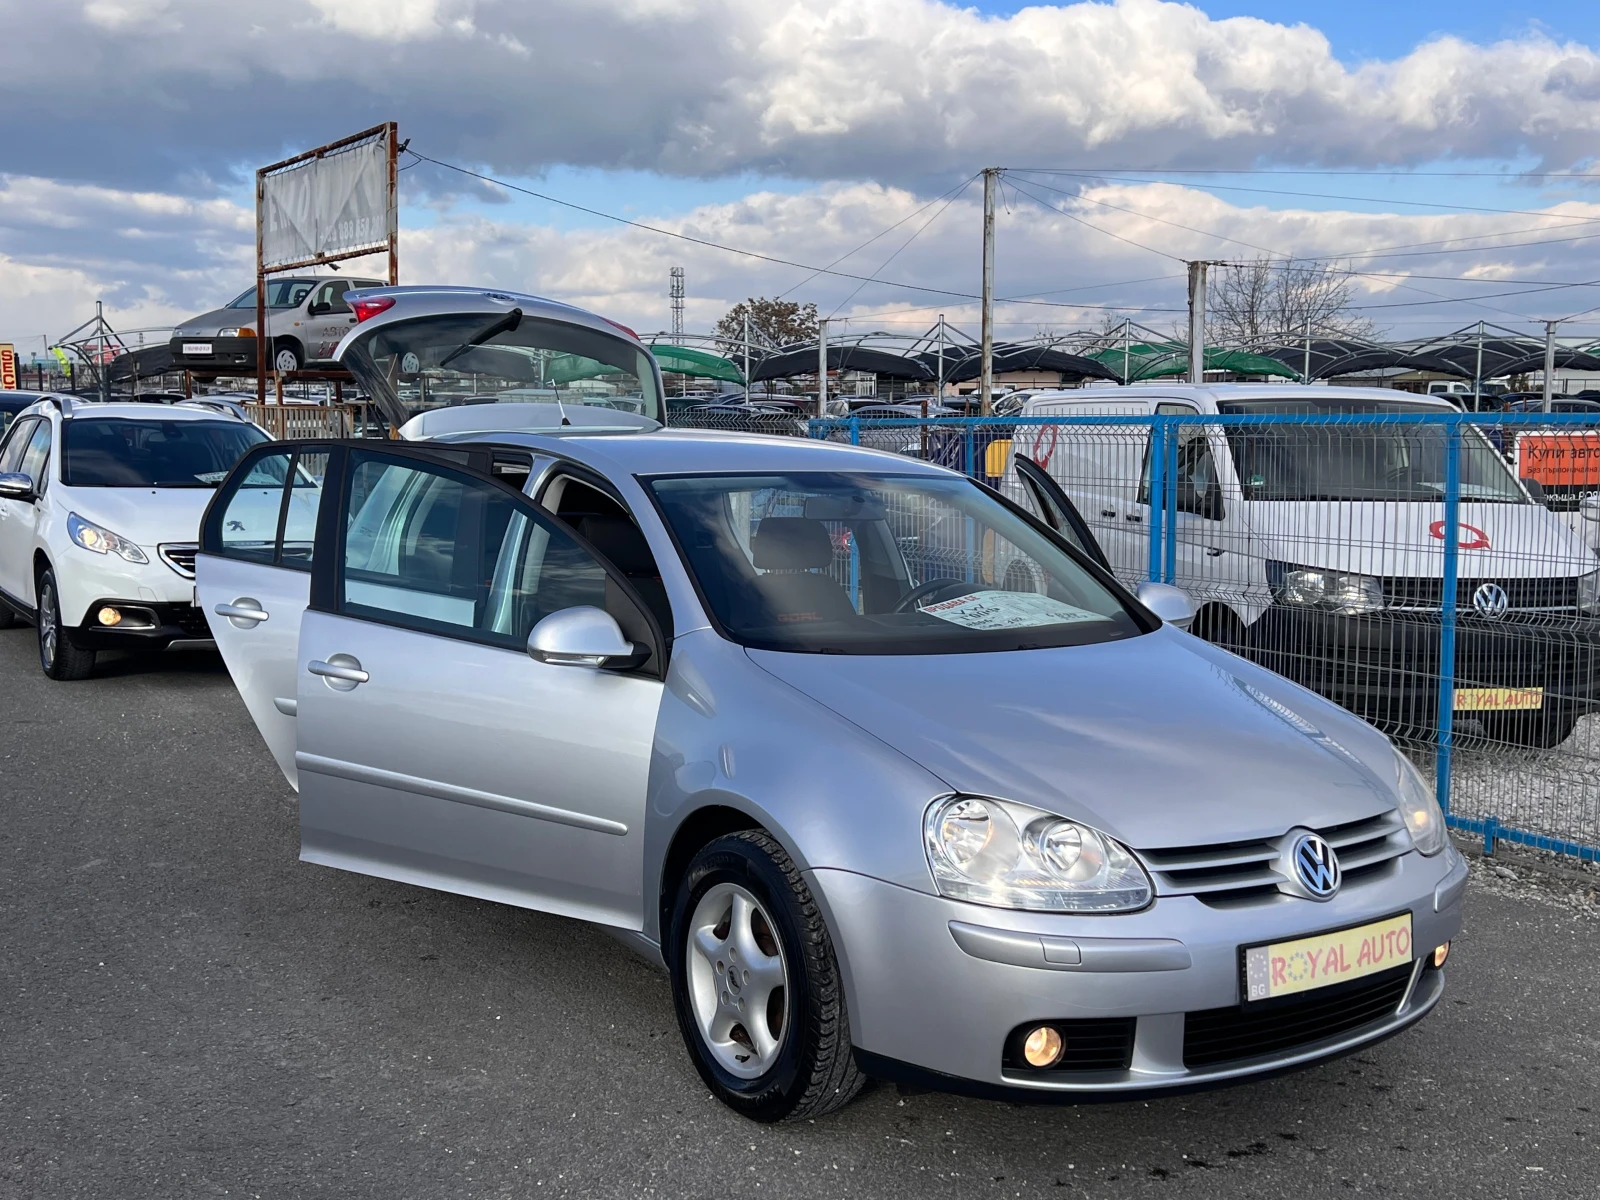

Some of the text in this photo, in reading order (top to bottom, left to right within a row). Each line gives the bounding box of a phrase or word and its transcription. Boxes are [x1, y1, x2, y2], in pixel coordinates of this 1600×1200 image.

[1, 349, 15, 389] SEC
[1528, 445, 1565, 461] Купи
[1504, 691, 1540, 706] AUTO
[1271, 944, 1351, 986] ROYAL
[1357, 926, 1410, 967] AUTO
[1251, 983, 1266, 997] BG
